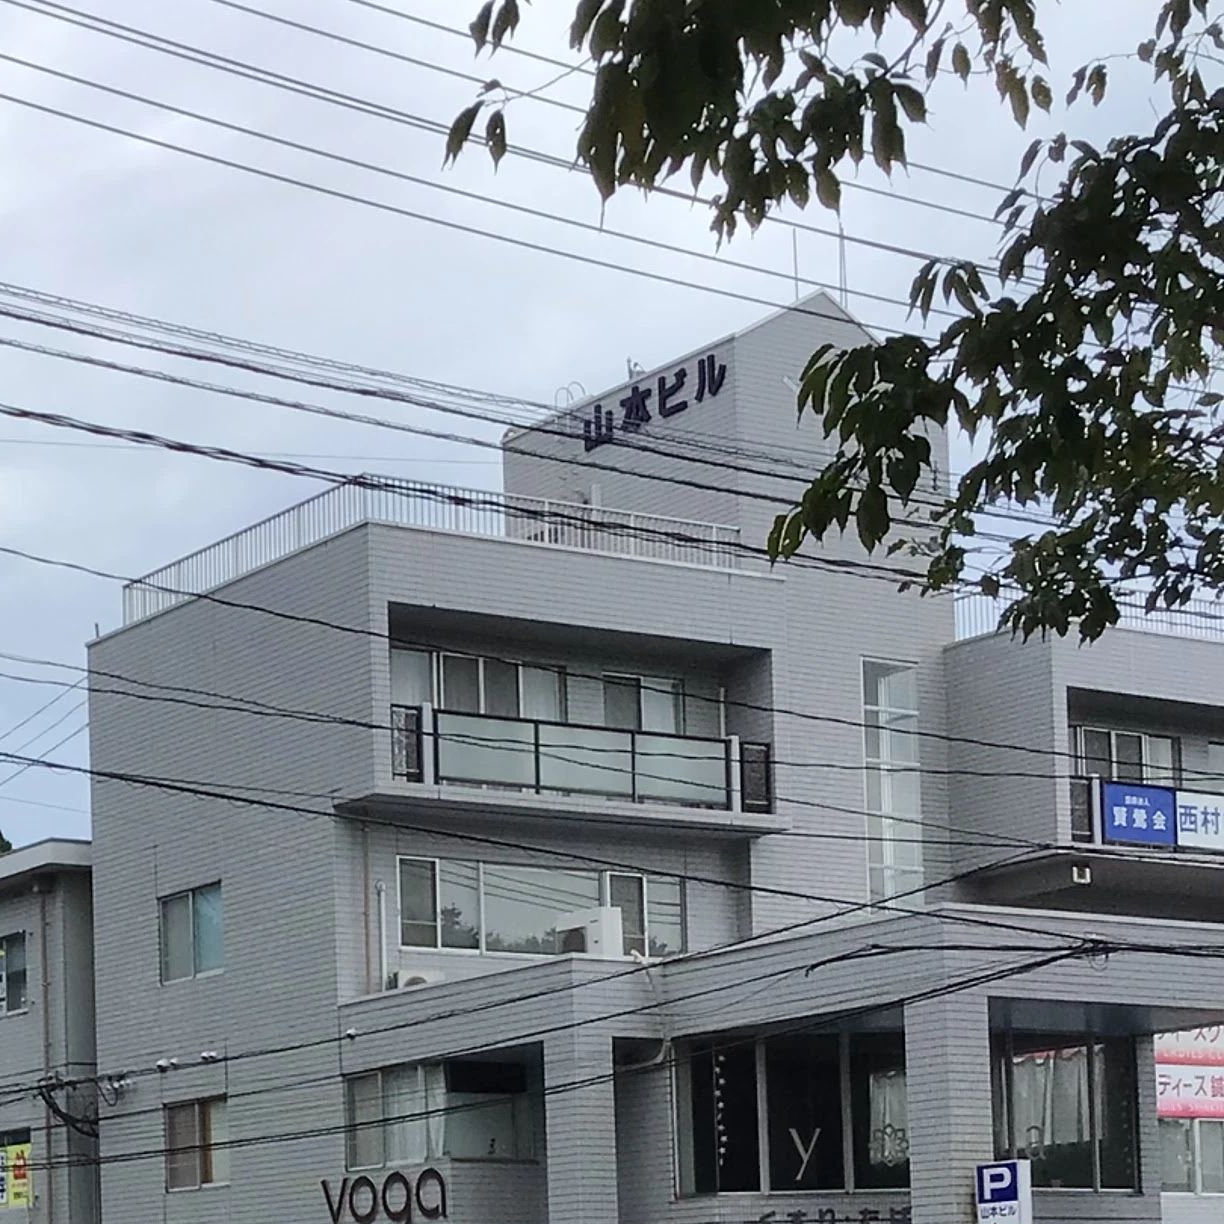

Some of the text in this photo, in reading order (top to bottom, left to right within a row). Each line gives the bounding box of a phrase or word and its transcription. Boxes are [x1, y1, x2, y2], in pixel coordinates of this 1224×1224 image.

[584, 354, 727, 452] 山本ビル
[1178, 804, 1221, 836] 西村
[982, 1166, 1012, 1200] P
[981, 1204, 1017, 1219] 山本ビル
